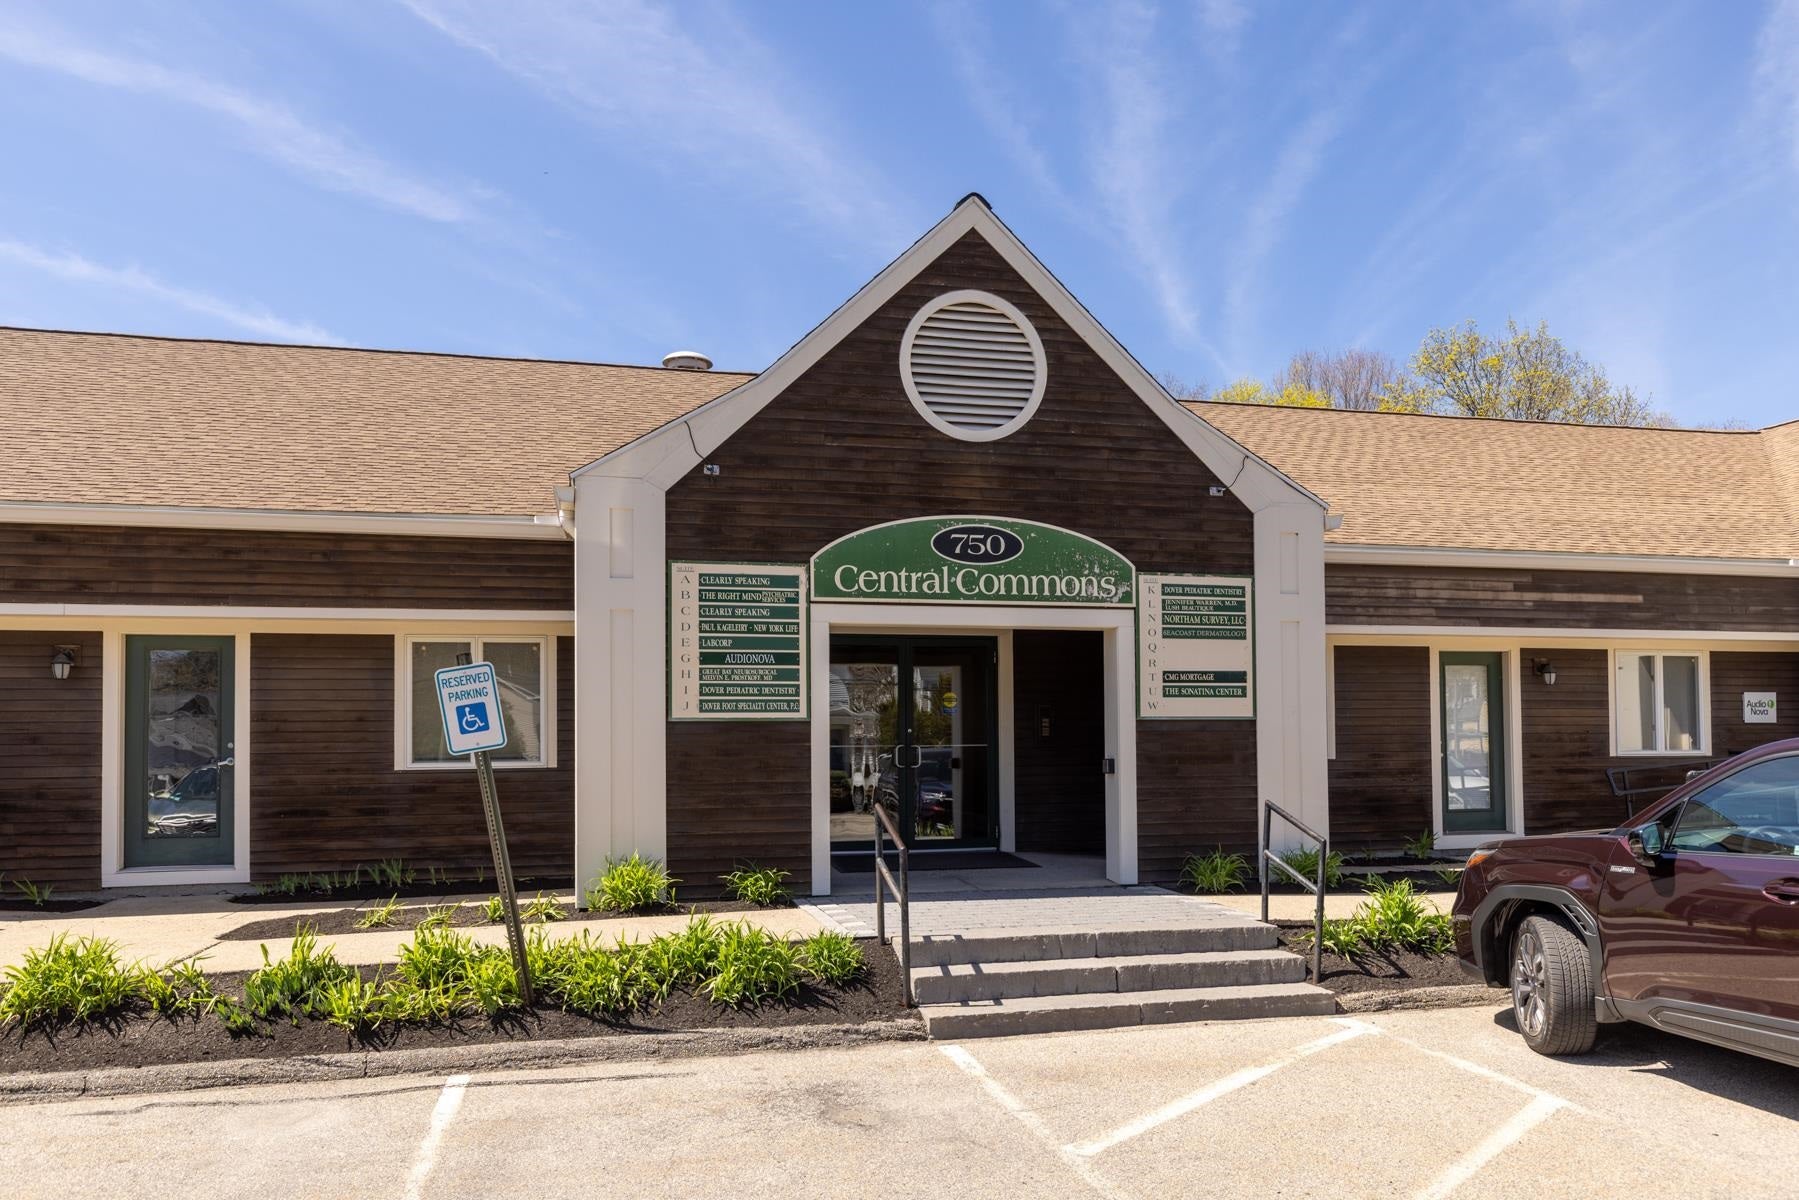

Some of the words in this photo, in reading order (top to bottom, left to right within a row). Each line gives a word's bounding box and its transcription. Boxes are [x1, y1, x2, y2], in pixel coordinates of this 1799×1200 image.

[950, 534, 1005, 556] 750
[681, 576, 690, 584] A
[701, 577, 733, 585] CLEARLY
[735, 577, 770, 585] SPEAKING
[835, 565, 949, 594] Central
[956, 569, 1117, 598] Commons
[1148, 586, 1155, 594] K
[681, 591, 690, 599] B
[717, 592, 740, 600] RIGHT
[681, 607, 690, 616] C
[701, 608, 733, 616] CLEARLY
[735, 608, 770, 616] SPEAKING
[1148, 614, 1155, 622] N
[1165, 615, 1200, 623] NORTHAM
[1202, 616, 1230, 625] SURVEY,
[681, 623, 690, 631] D
[701, 623, 715, 631] PAUL
[754, 624, 767, 632] NEW
[681, 638, 690, 647] E
[702, 639, 732, 647] LABCORP
[1148, 643, 1157, 653] Q
[681, 654, 690, 663] G
[725, 655, 775, 664] AUDIONOVA
[1148, 659, 1156, 667] R
[681, 670, 690, 678] H
[1149, 673, 1156, 681] T
[441, 672, 489, 688] RESERVED
[684, 686, 688, 694] I
[448, 687, 488, 702] PARKING
[683, 702, 689, 710] J
[1148, 702, 1158, 710] W
[1747, 700, 1766, 708] Audio
